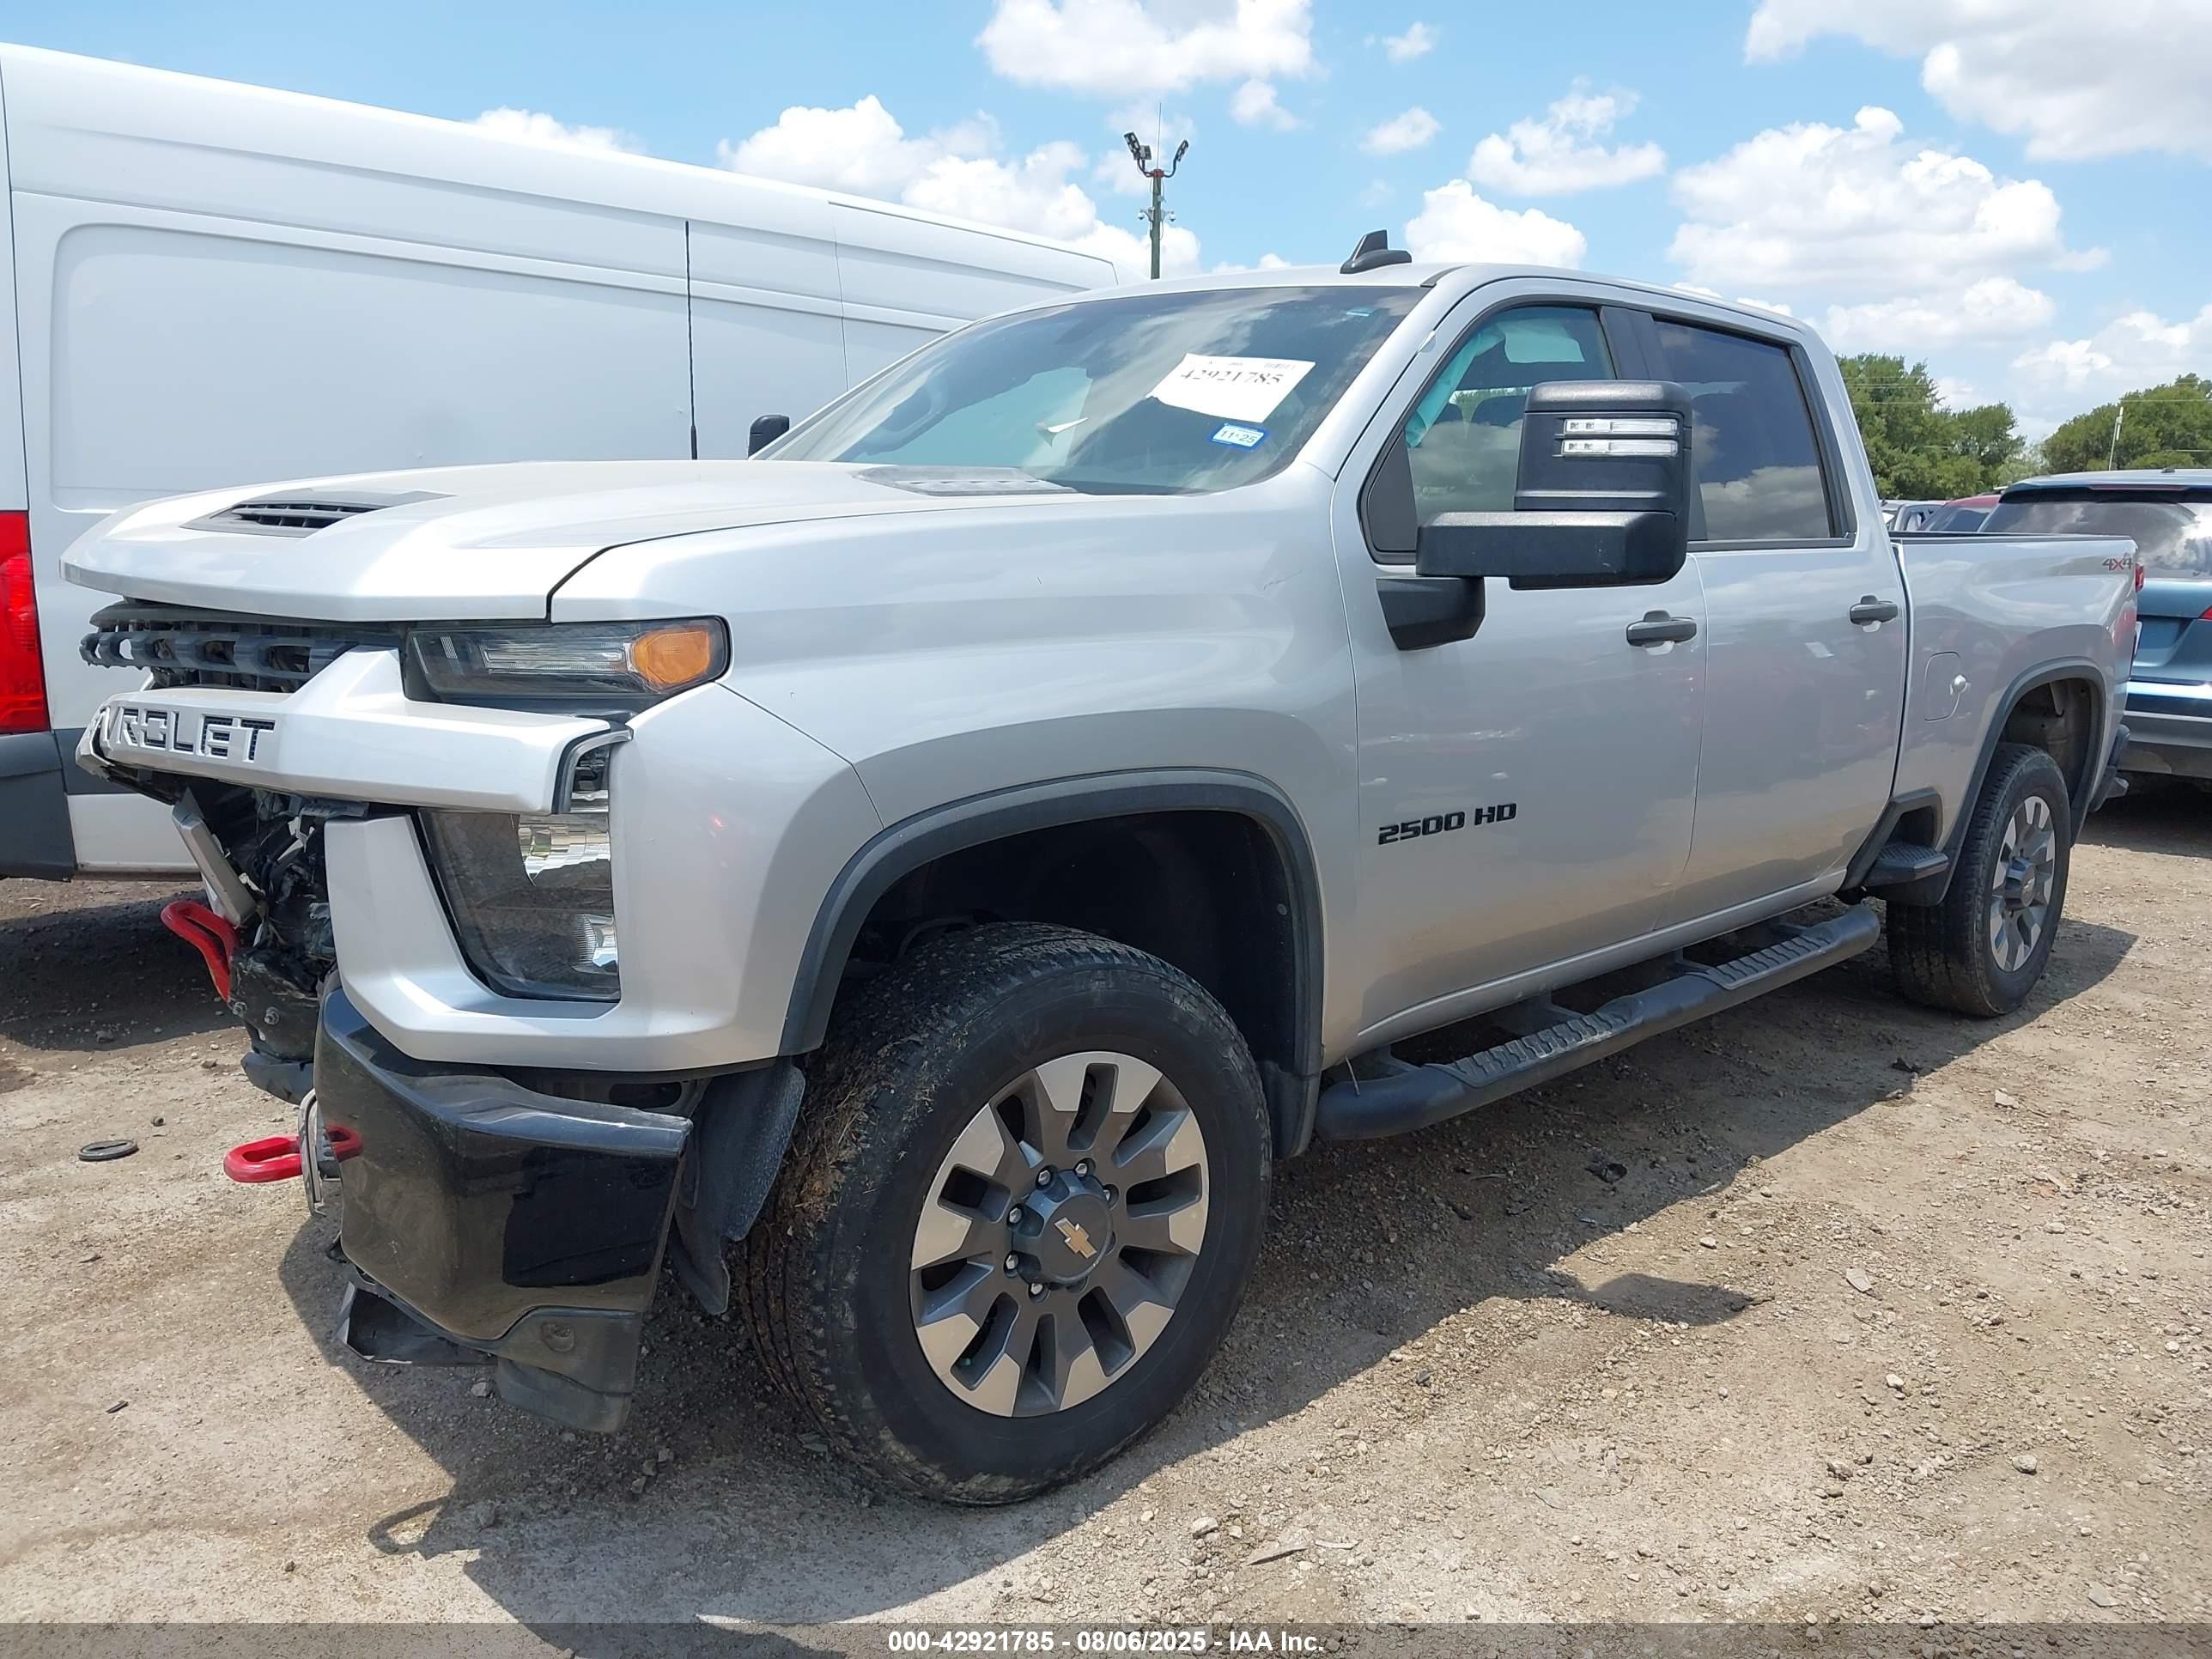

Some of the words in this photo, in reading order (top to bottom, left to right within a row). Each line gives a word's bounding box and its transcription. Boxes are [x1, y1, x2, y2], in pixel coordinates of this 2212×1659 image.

[1182, 369, 1284, 385] 42921785
[1378, 811, 1465, 845] 2500
[1474, 803, 1517, 826] HD
